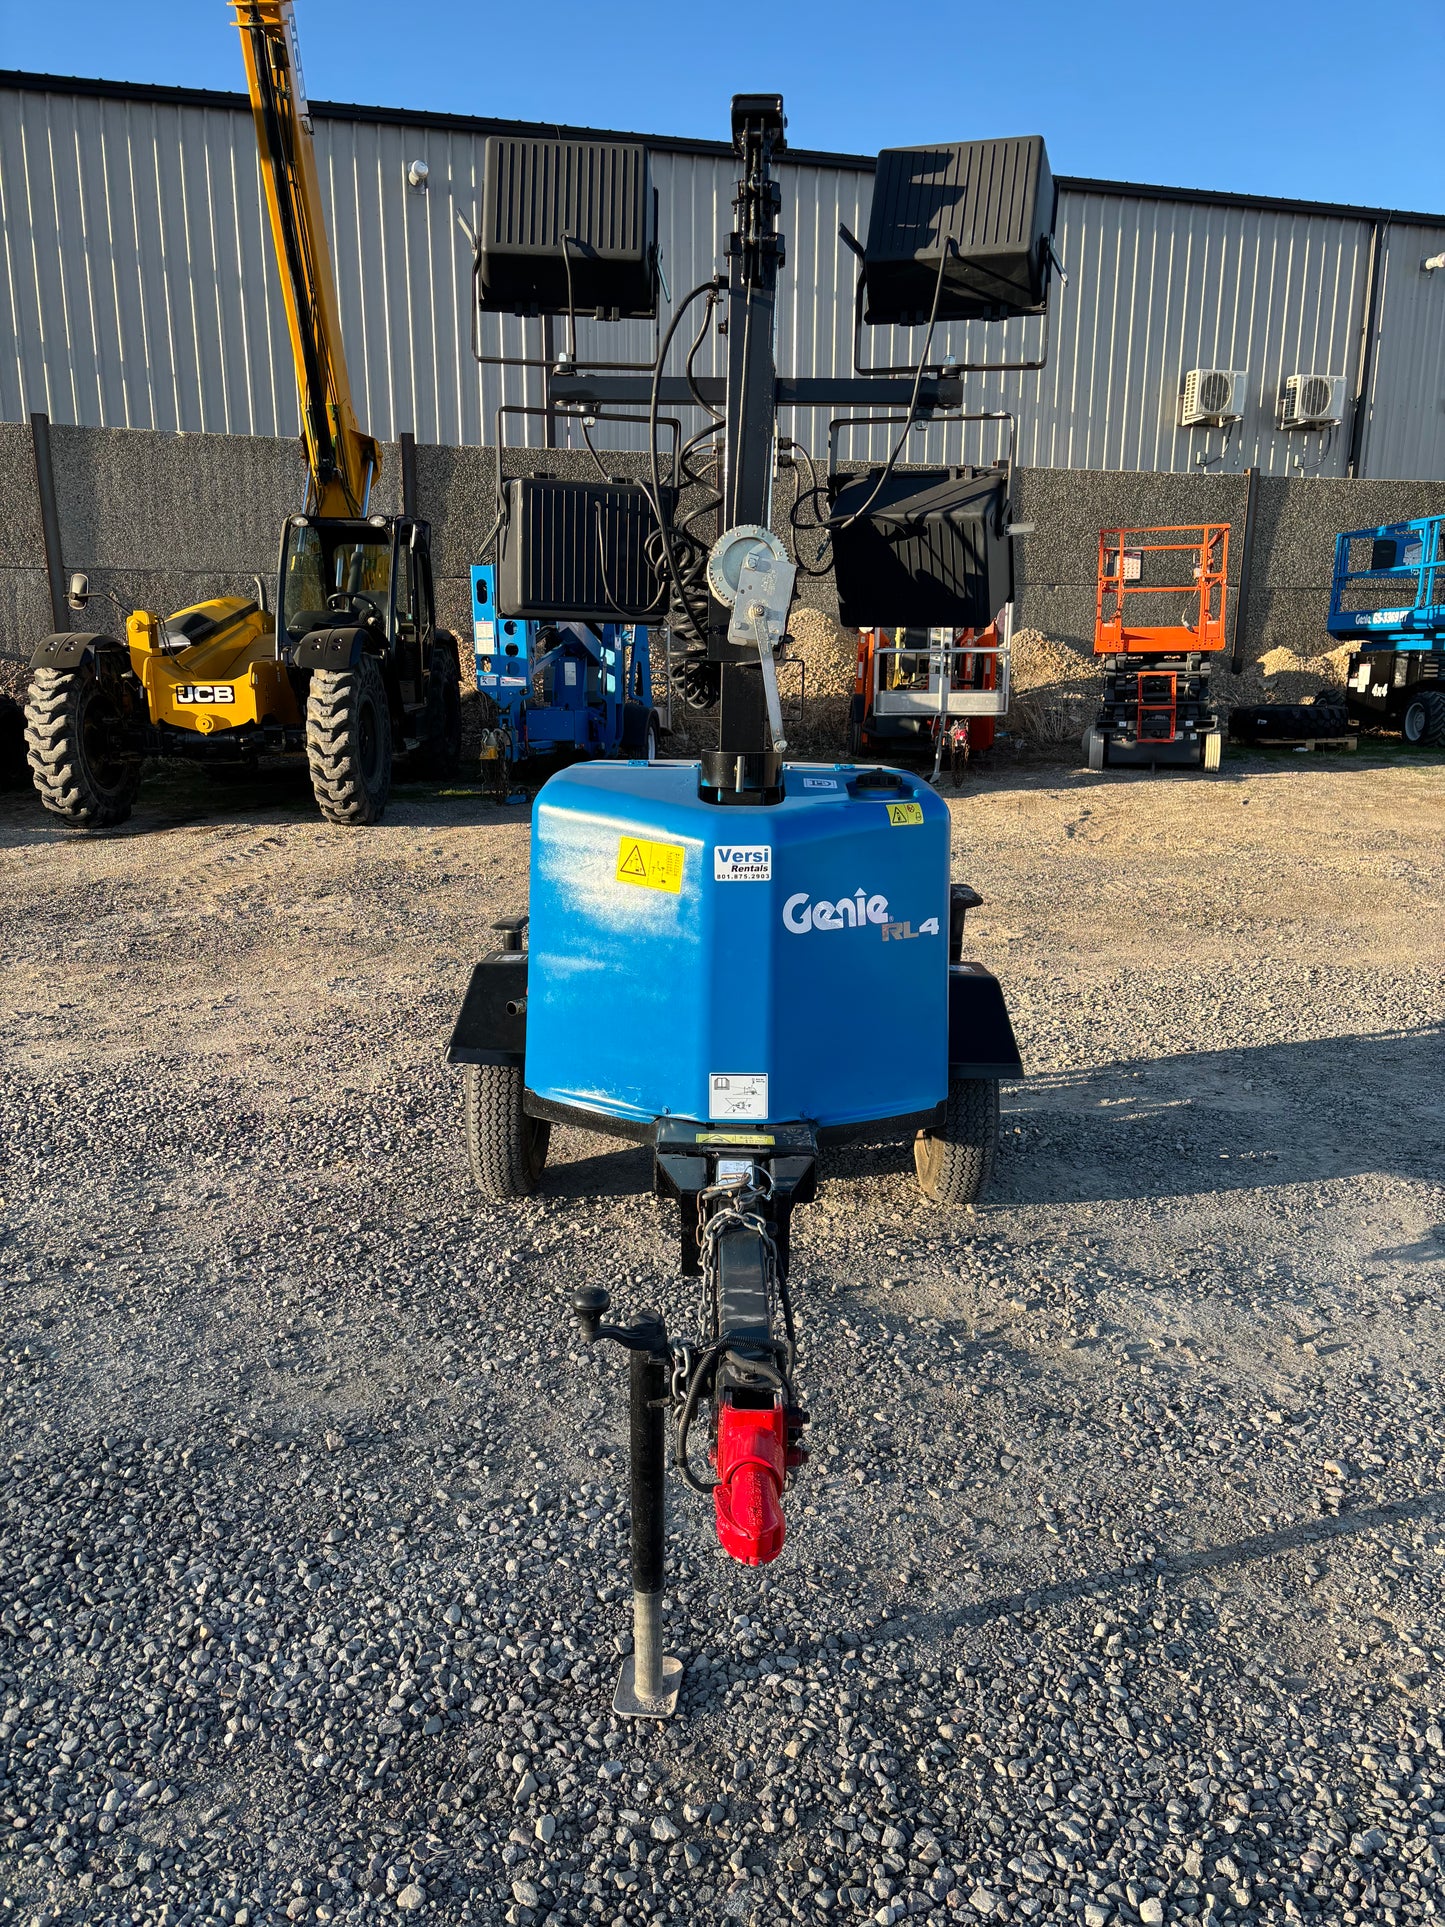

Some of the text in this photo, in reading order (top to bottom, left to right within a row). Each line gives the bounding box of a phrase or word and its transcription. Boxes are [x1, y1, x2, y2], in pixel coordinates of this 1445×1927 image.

[177, 686, 234, 703] JCB
[1371, 682, 1388, 697] 4x4
[717, 848, 769, 863] Versi
[731, 864, 769, 872] Rentals
[782, 887, 889, 935] Genie
[881, 916, 940, 942] RL4
